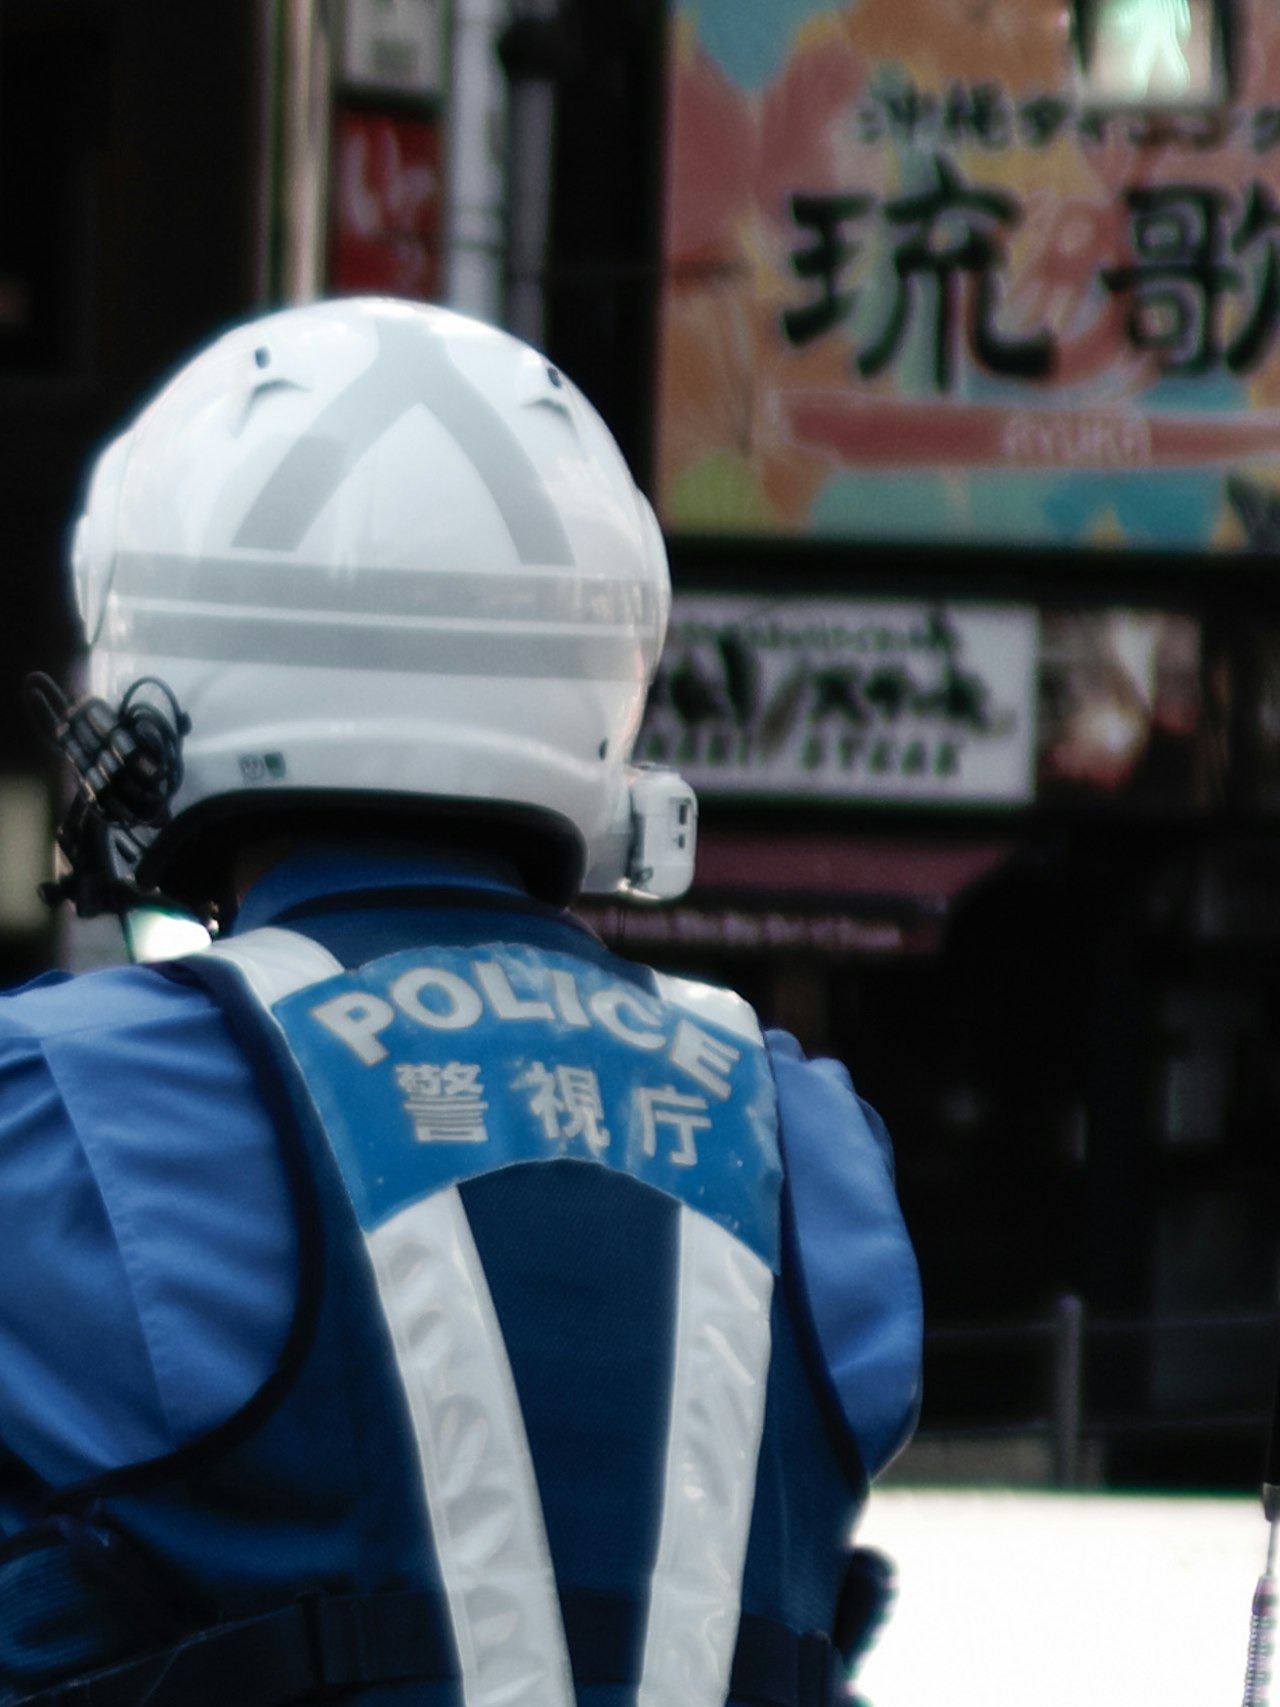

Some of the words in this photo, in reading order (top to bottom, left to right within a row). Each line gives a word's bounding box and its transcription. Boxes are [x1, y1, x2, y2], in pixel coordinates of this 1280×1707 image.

[999, 411, 1152, 465] RYUKA
[311, 962, 741, 1101] POLICE
[394, 1061, 713, 1167] 警視庁
